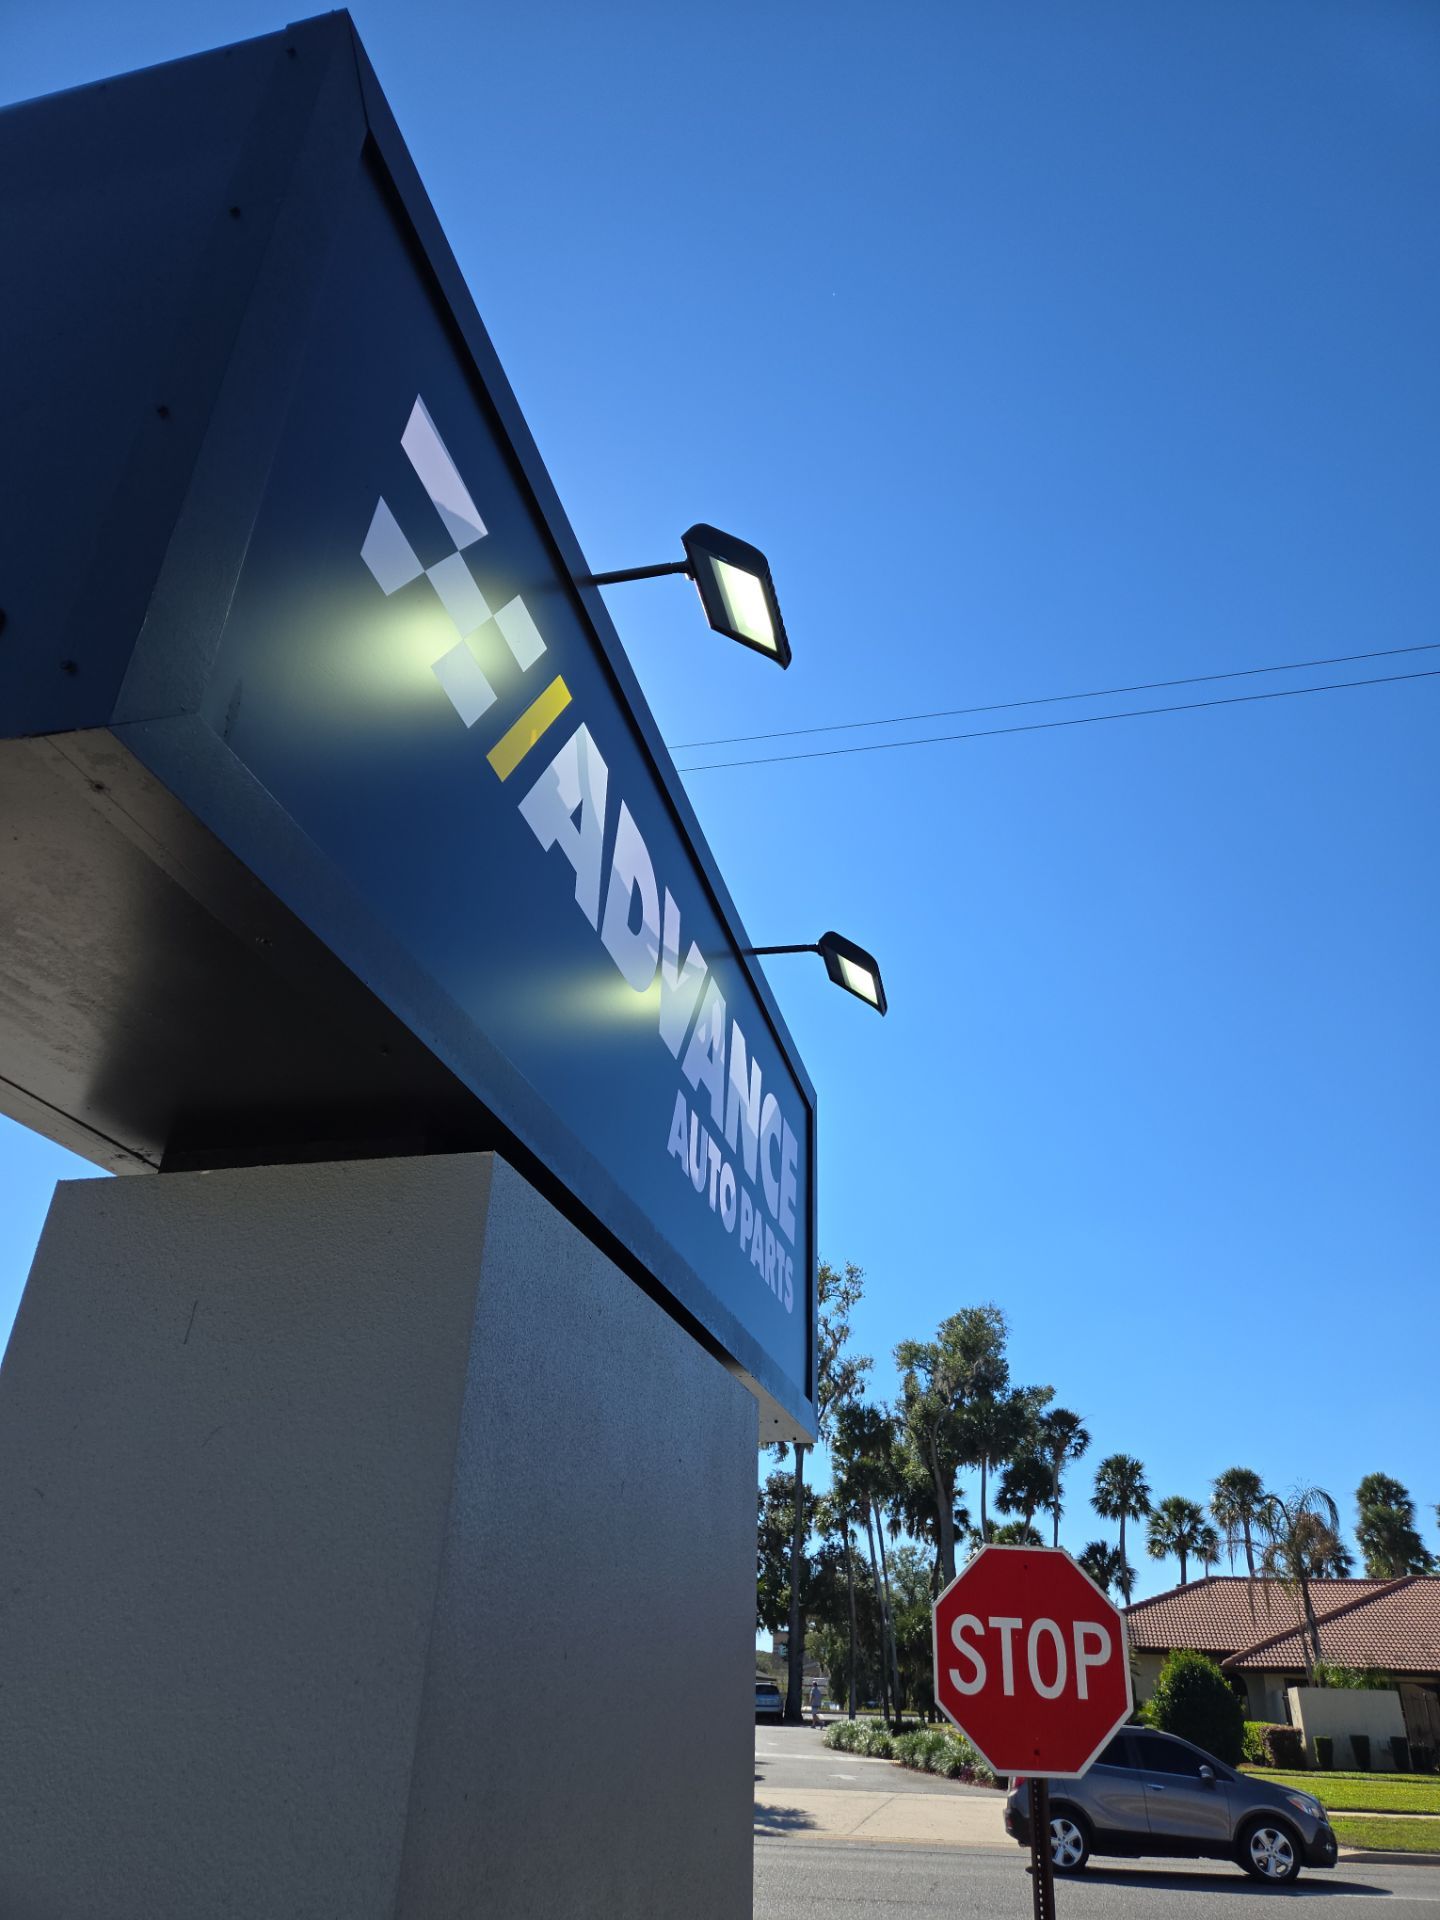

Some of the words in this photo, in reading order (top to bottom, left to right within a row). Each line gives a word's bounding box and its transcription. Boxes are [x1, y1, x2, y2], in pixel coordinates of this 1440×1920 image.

[517, 721, 798, 1247] ADVANCE
[667, 1089, 736, 1233] AUTO
[740, 1186, 793, 1314] PARTS
[949, 1613, 1112, 1700] STOP
